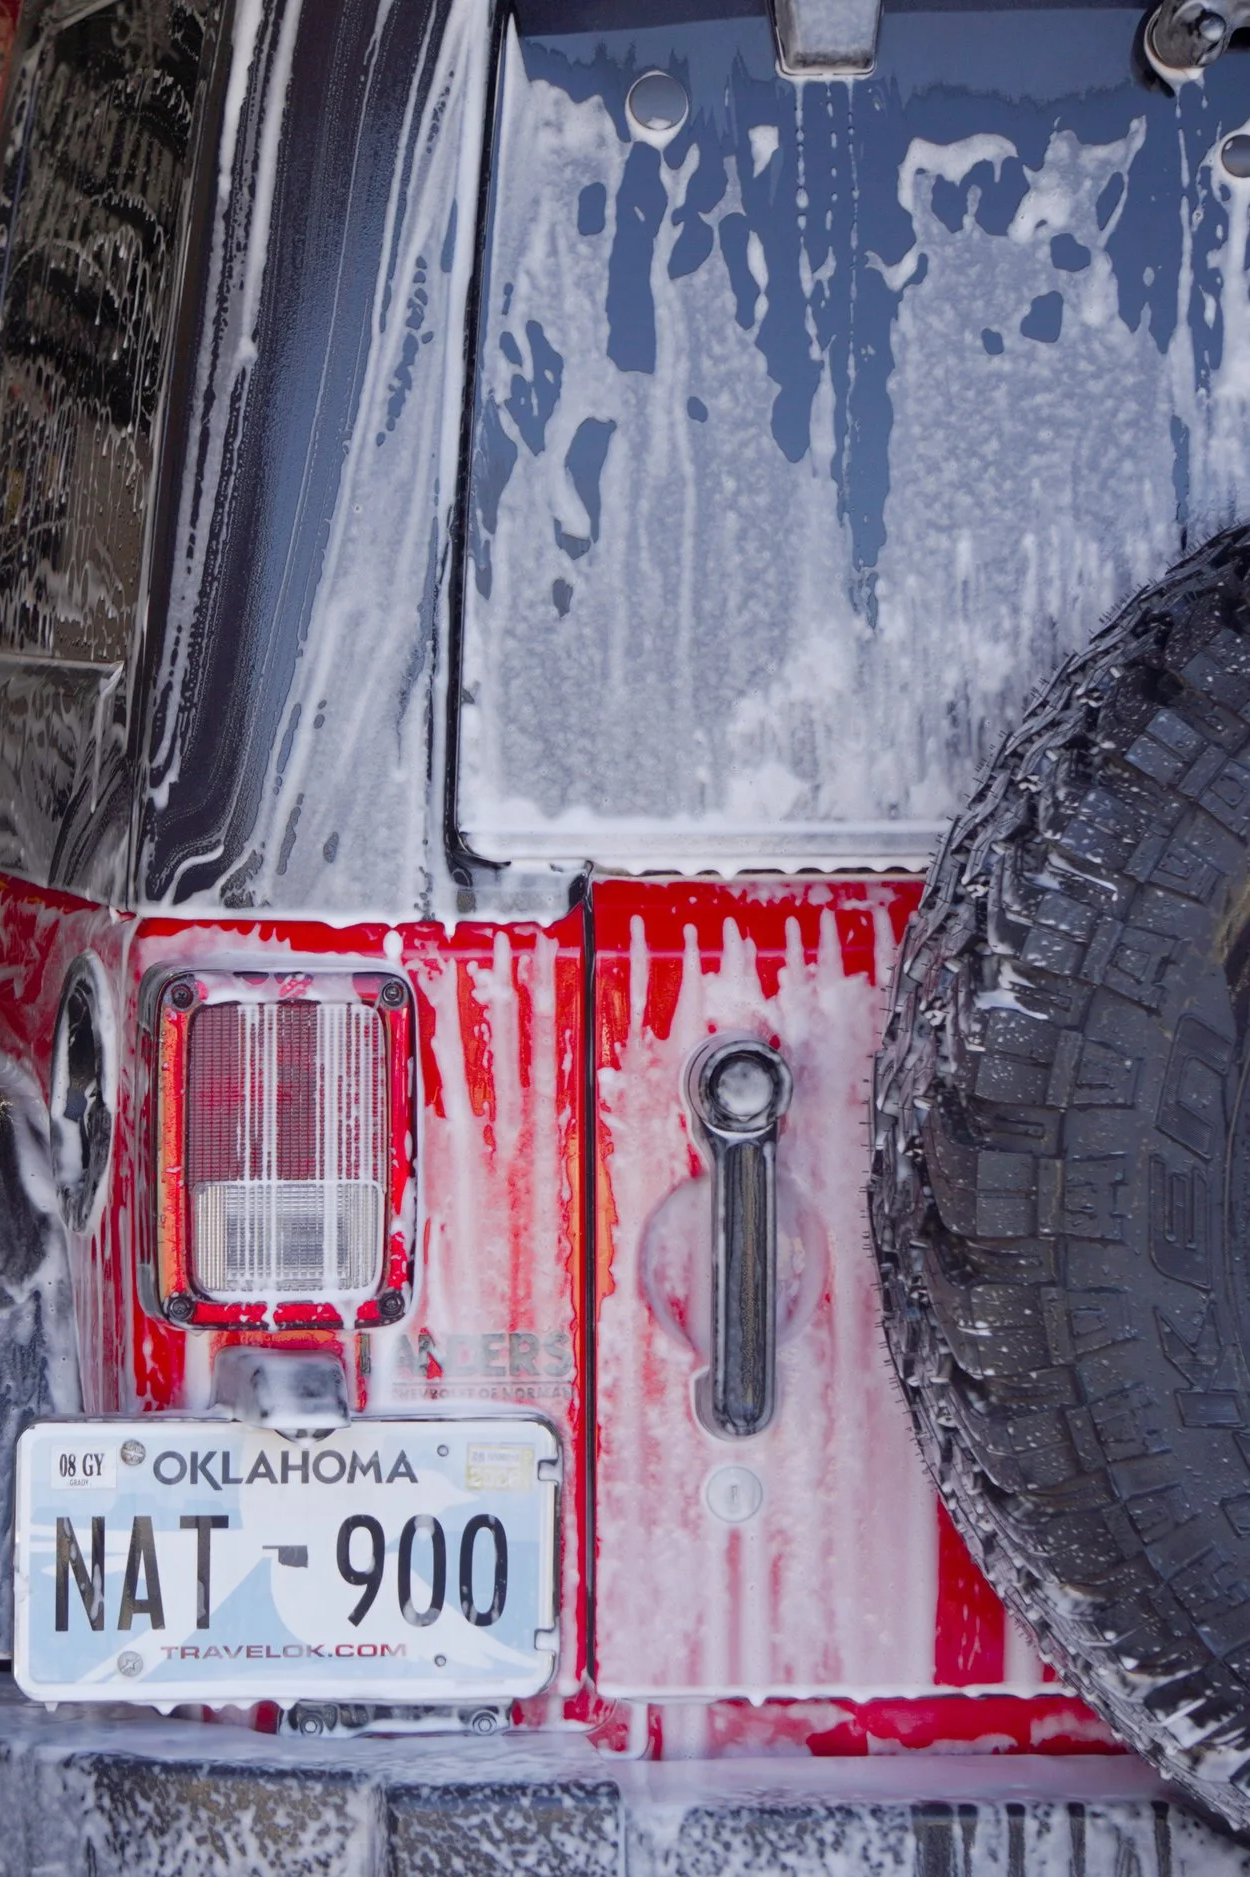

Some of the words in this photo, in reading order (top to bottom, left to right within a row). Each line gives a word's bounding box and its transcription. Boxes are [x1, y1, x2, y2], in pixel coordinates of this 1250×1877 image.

[59, 1453, 76, 1478] 08
[82, 1453, 105, 1477] GY
[152, 1449, 419, 1490] OKLAHOMA
[55, 1515, 230, 1631] NAT
[336, 1513, 509, 1628] 900
[160, 1643, 407, 1661] TRAVELOK.COM
